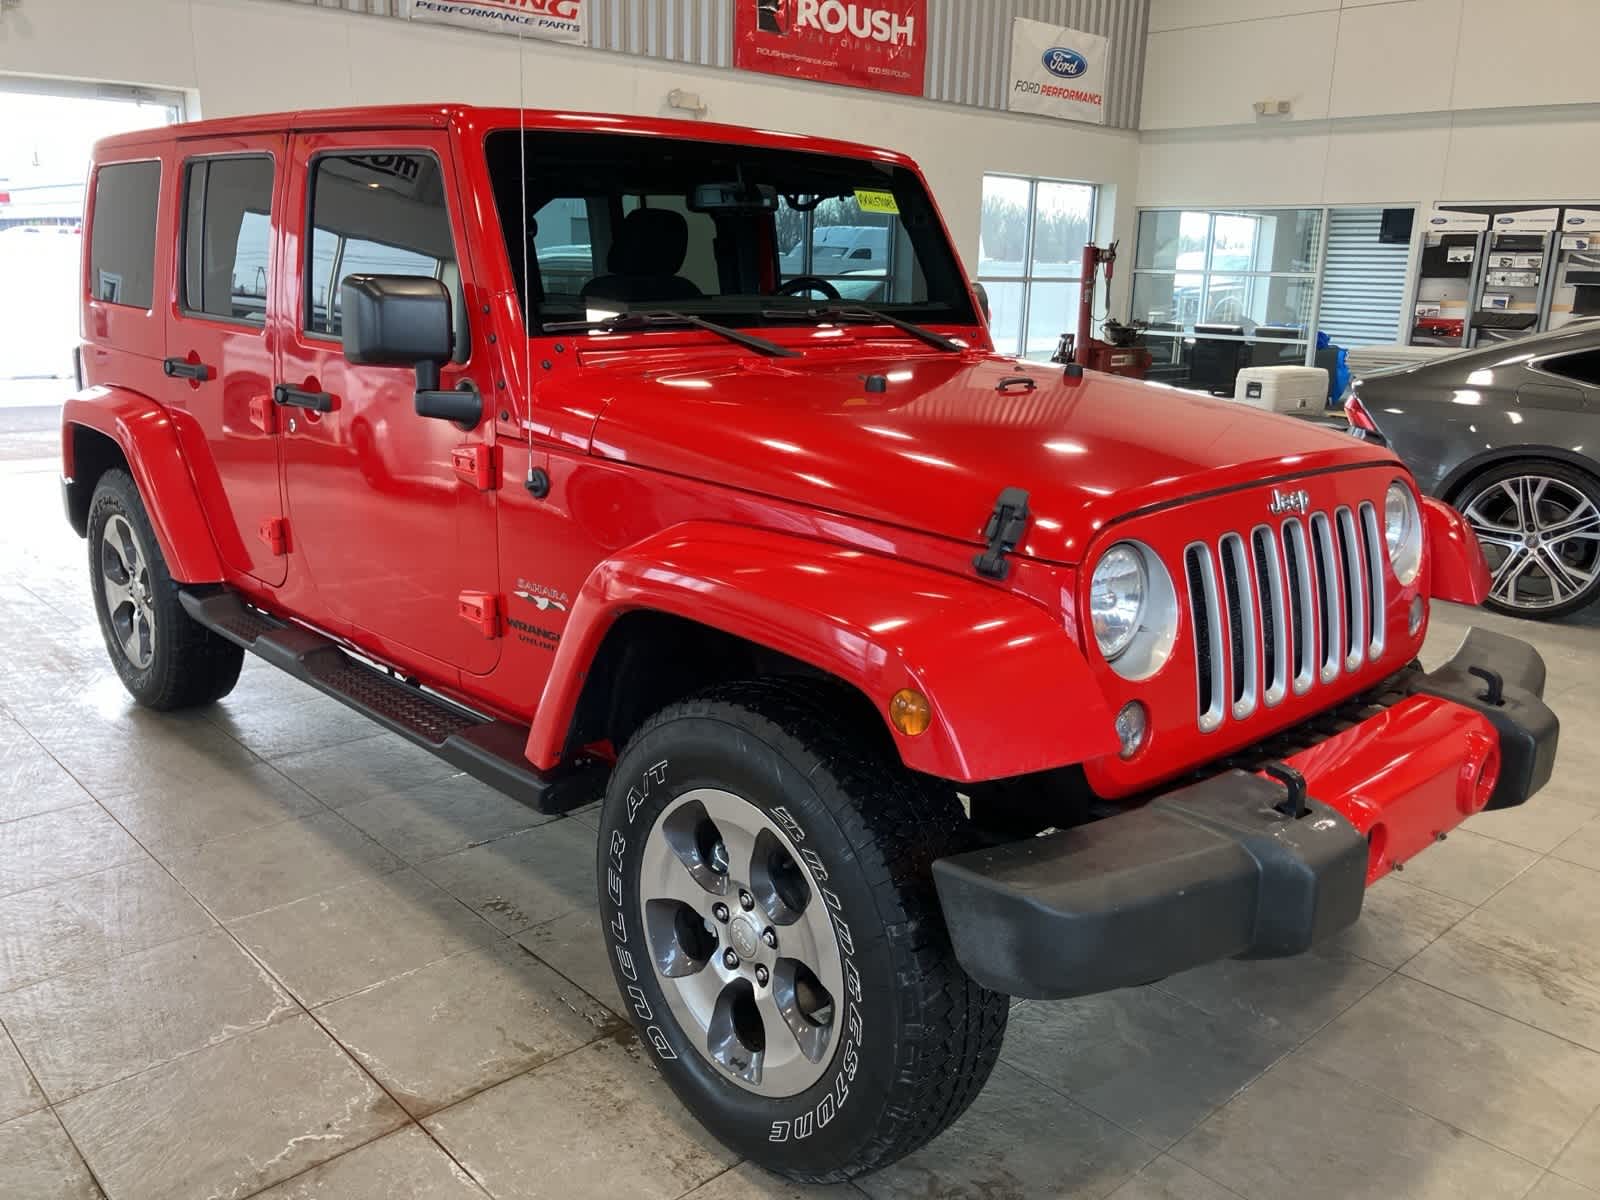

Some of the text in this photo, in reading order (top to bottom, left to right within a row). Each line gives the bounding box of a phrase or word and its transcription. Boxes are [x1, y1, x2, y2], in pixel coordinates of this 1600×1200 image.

[416, 0, 581, 33] PERFORMANCE PARTS
[796, 0, 915, 47] ROUSH
[1049, 51, 1078, 74] Ford
[1014, 80, 1102, 106] FORD PERFORMANCE
[1267, 489, 1309, 515] Jeep
[607, 759, 679, 1060] DUELER A/T
[768, 805, 864, 1142] BRIDGESTONE
